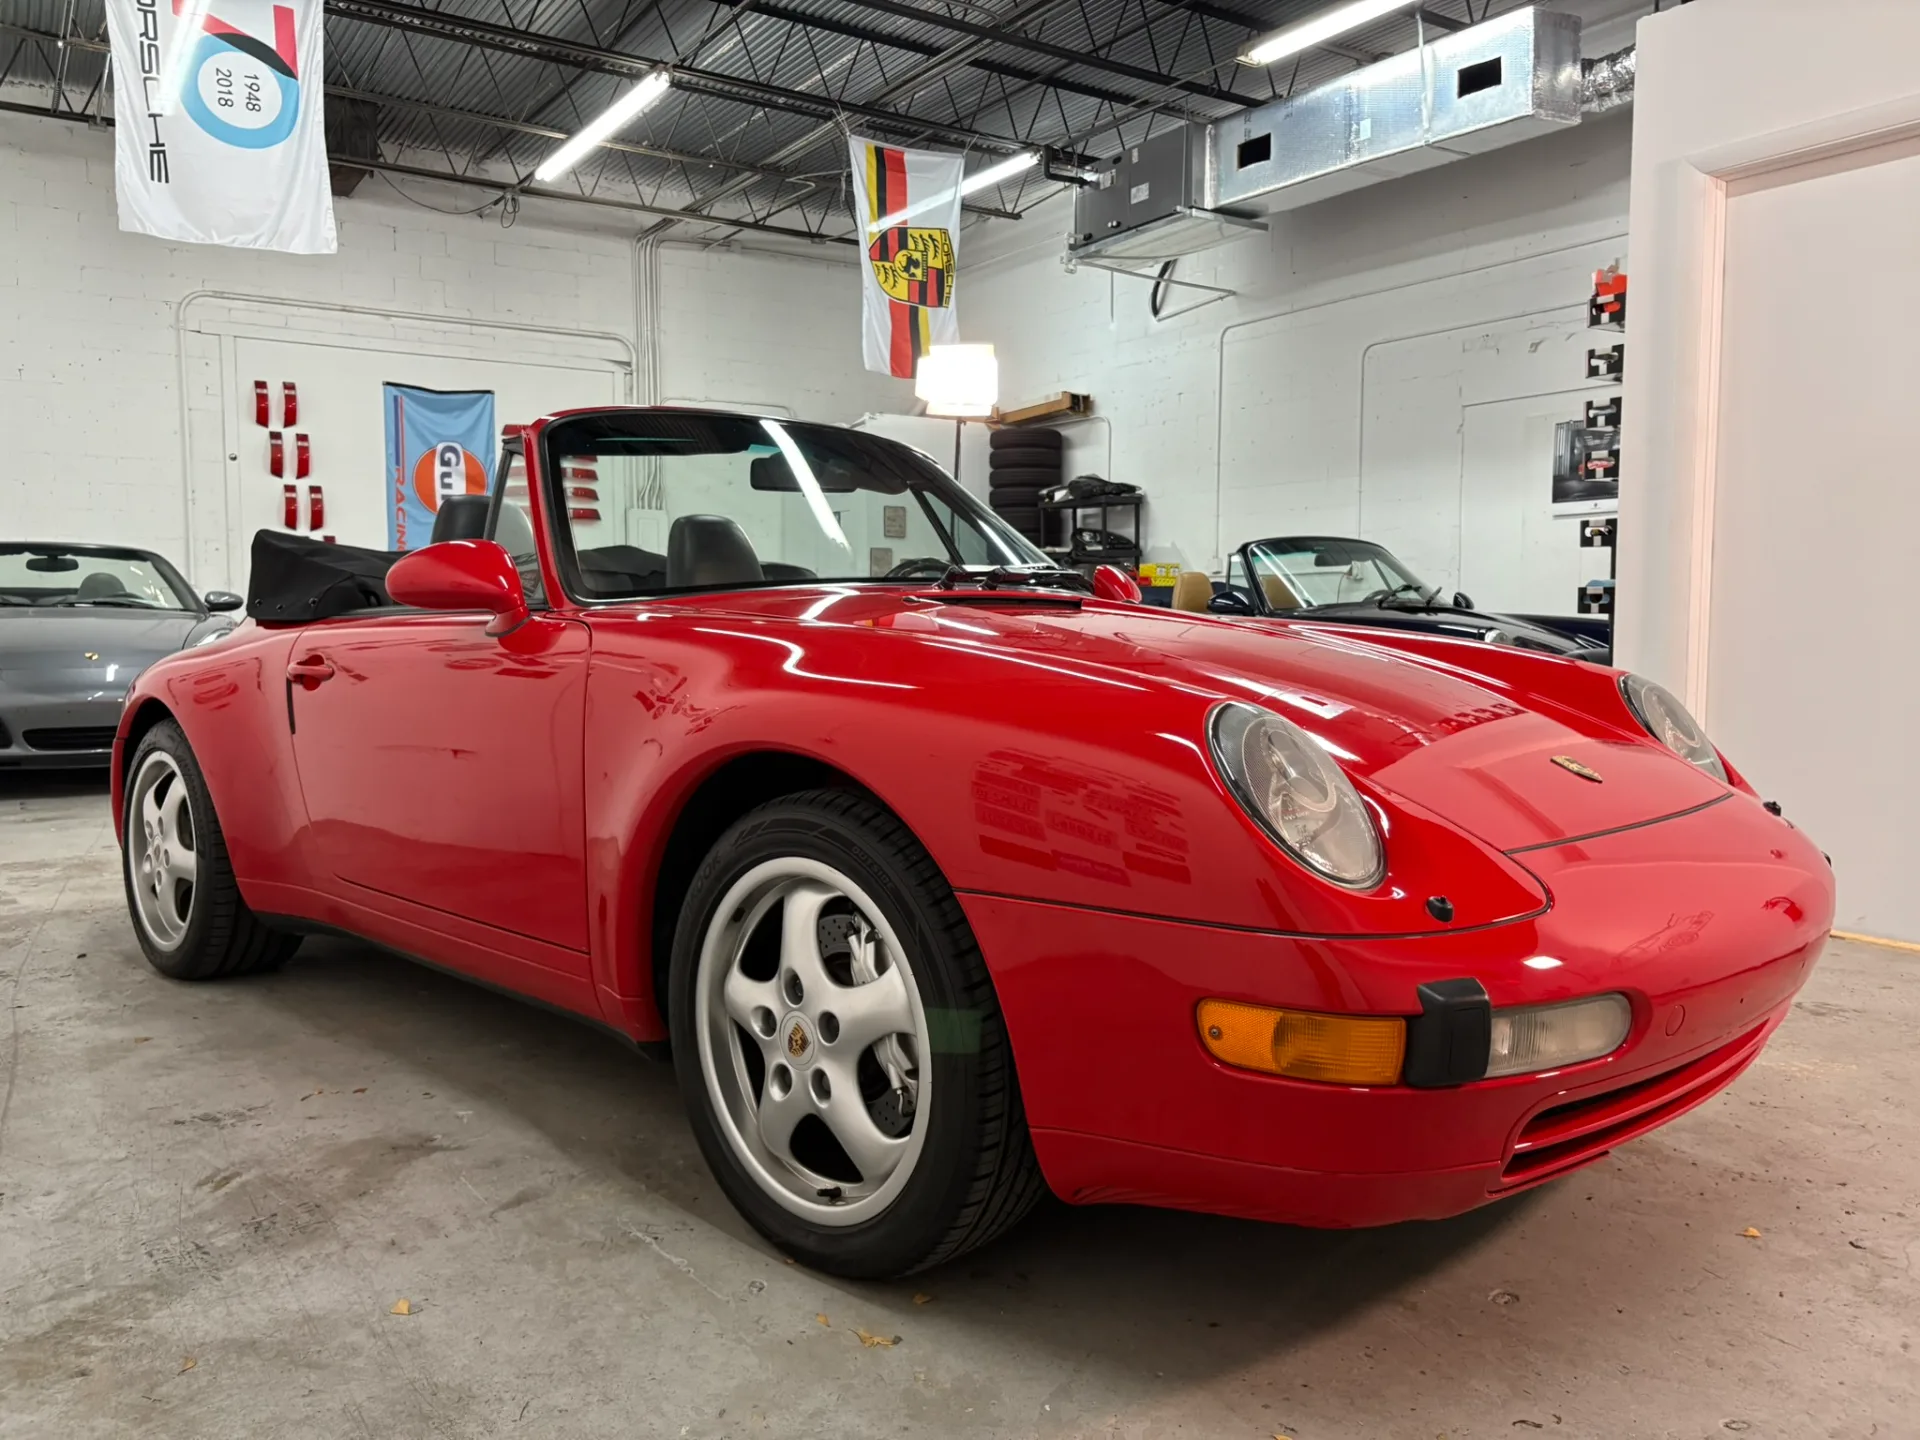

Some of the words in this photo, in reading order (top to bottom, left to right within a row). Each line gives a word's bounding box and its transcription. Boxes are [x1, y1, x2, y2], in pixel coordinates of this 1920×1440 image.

[136, 0, 170, 184] RSCHE
[215, 67, 234, 109] 2018
[243, 73, 262, 113] 1948
[942, 231, 953, 305] PORSCHE
[440, 445, 461, 500] Gu
[395, 466, 407, 551] RACIN
